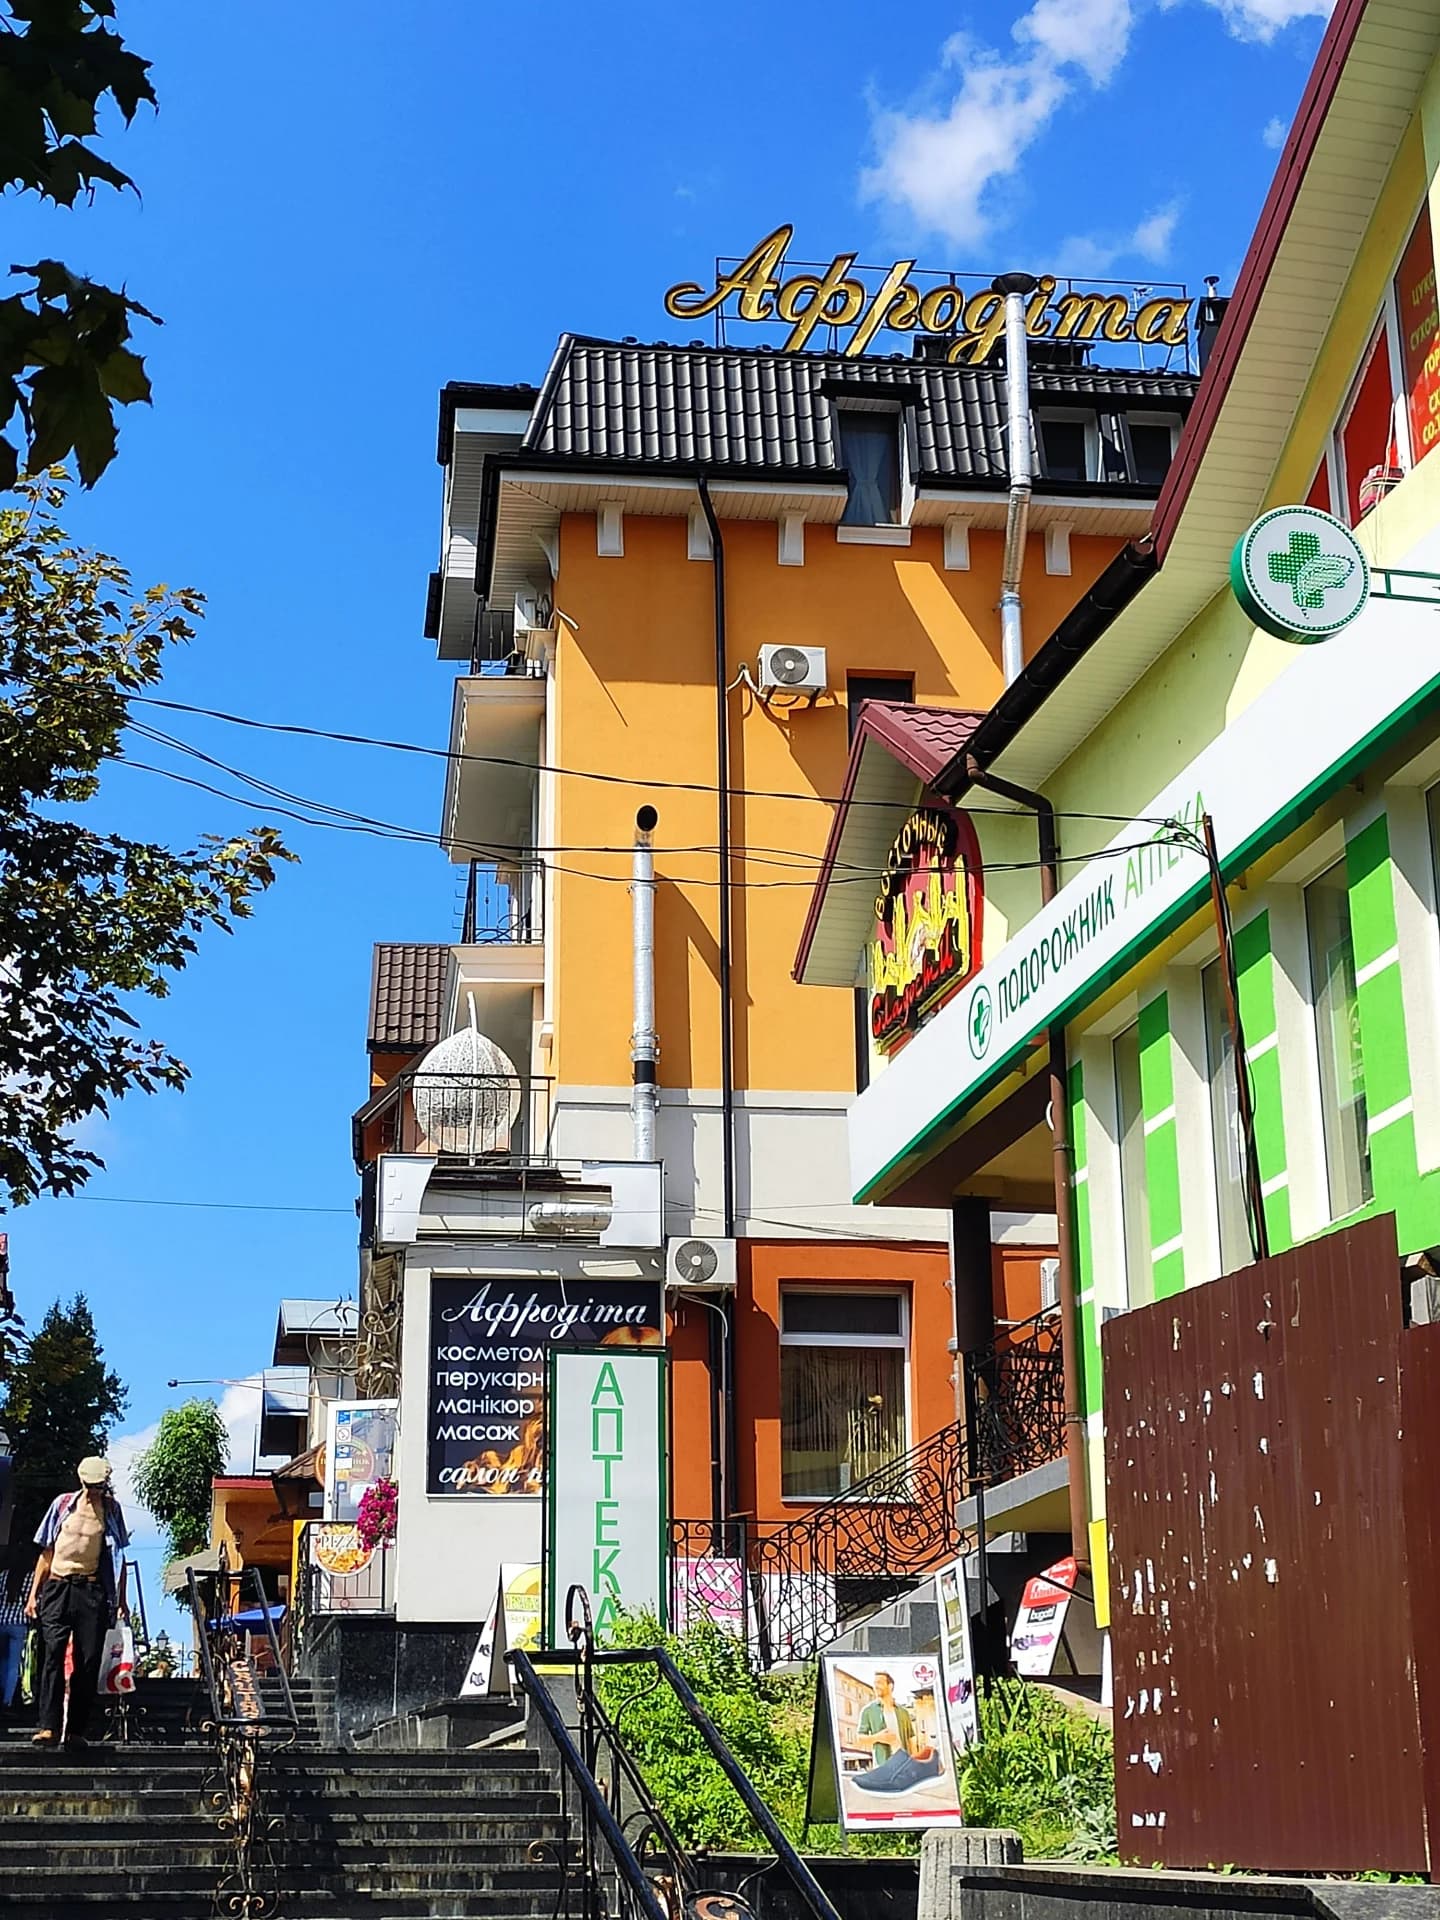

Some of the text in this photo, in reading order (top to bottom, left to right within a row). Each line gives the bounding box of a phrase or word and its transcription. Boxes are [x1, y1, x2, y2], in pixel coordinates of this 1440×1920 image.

[999, 873, 1116, 1024] ПОДОРОЖНИК
[441, 1282, 647, 1340] Афродіта
[437, 1346, 545, 1362] косметол
[436, 1370, 545, 1391] перукарн
[436, 1394, 535, 1418] манікюр
[436, 1424, 520, 1441] масаж
[591, 1361, 624, 1637] АПТЕКА
[320, 1533, 360, 1549] PIZZ
